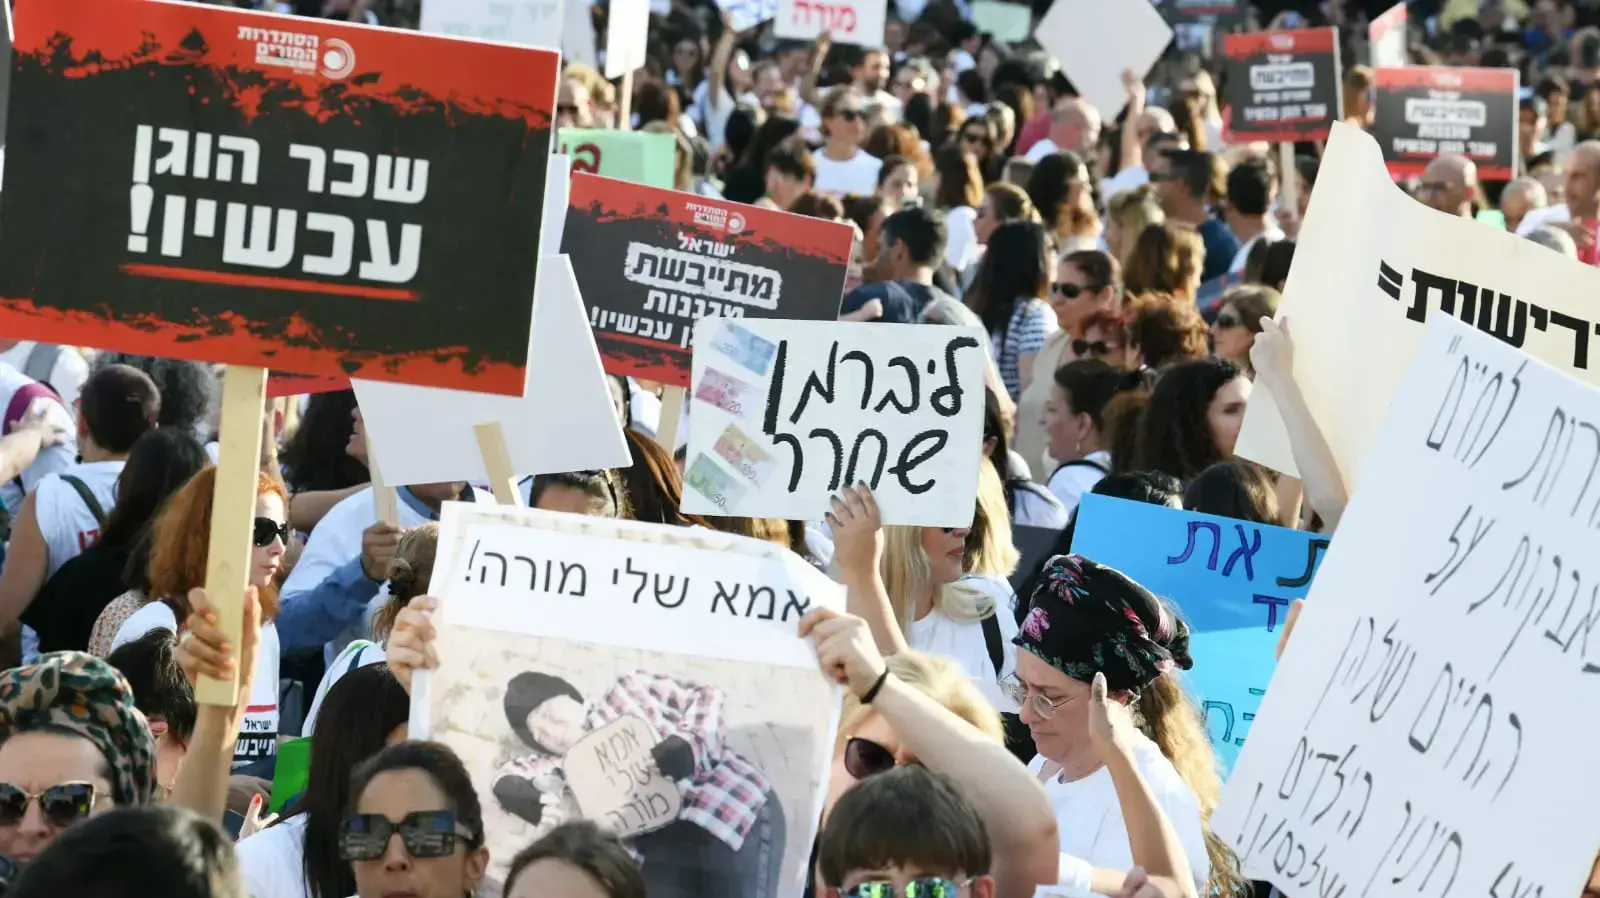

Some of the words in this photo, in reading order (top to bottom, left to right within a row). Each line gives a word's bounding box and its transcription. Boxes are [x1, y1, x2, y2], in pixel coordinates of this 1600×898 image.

[236, 26, 319, 48] הסתדרות
[256, 42, 318, 62] המורים
[132, 124, 261, 185] הוגן
[288, 142, 430, 205] שכר
[127, 183, 423, 284] עכשיו!
[677, 231, 736, 258] ישראל
[633, 252, 774, 300] מתייבשת
[590, 306, 674, 341] עכשיו!
[1376, 259, 1600, 370] רישות=
[762, 336, 980, 436] ליברמן
[773, 428, 949, 495] שחרר
[713, 494, 727, 508] 50
[463, 538, 588, 597] מורה!
[1167, 520, 1262, 582] את
[1424, 503, 1496, 596] על
[611, 556, 690, 609] שלי
[710, 580, 812, 622] אמא
[1467, 534, 1600, 683] אבקות
[1303, 616, 1417, 732] שלהן
[233, 738, 276, 756] תייבש
[244, 716, 272, 730] ישראל
[594, 723, 641, 773] אמא
[1408, 661, 1523, 803] החיים
